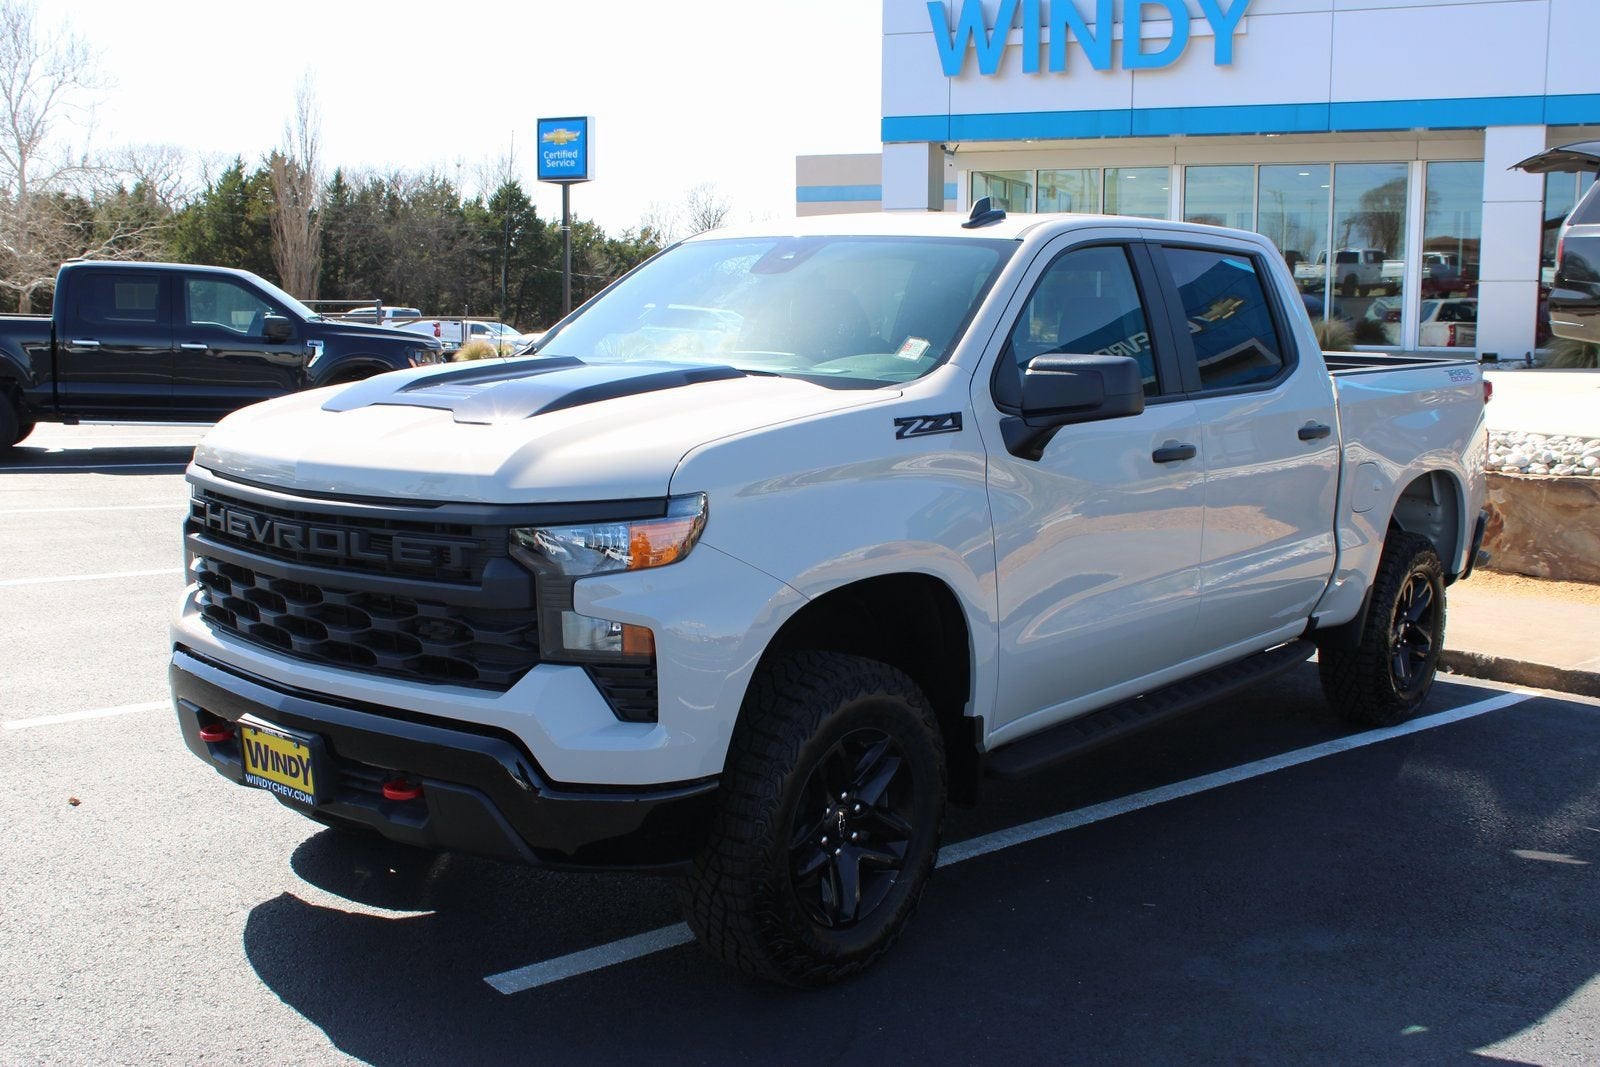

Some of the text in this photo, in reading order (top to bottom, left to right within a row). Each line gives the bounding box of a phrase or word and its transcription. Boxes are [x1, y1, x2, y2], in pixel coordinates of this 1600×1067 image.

[927, 0, 1250, 77] WINDY
[543, 149, 578, 160] Certified
[546, 159, 576, 168] Service
[189, 497, 484, 568] CHEVROLET
[245, 738, 312, 787] WINDY
[245, 773, 314, 805] WINDYCHEV.COM
